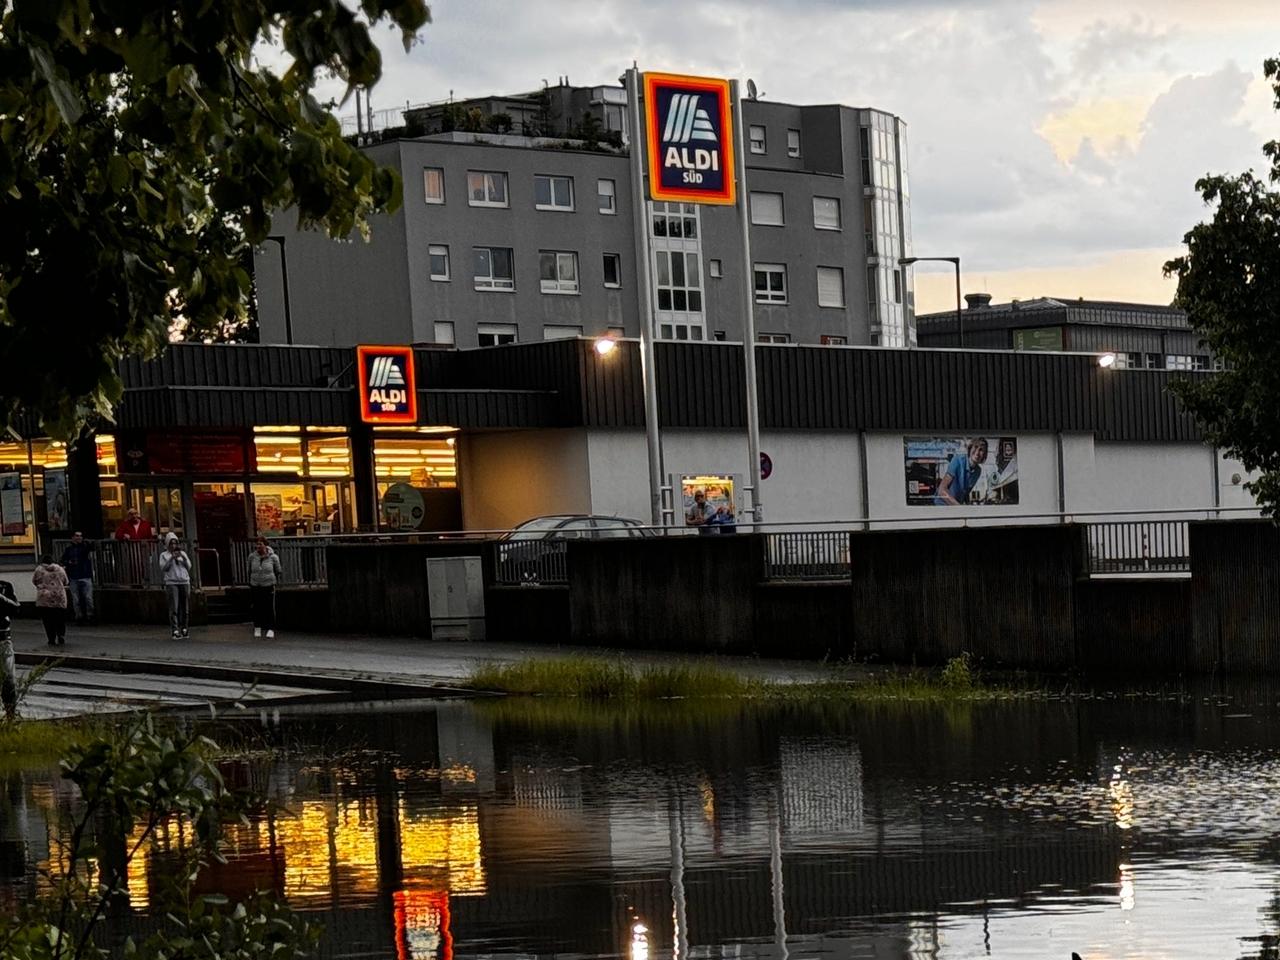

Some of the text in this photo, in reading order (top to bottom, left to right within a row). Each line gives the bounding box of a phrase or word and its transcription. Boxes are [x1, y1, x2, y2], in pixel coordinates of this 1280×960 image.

[664, 146, 719, 171] ALDI
[682, 170, 703, 183] SÜD
[369, 389, 406, 403] ALDI
